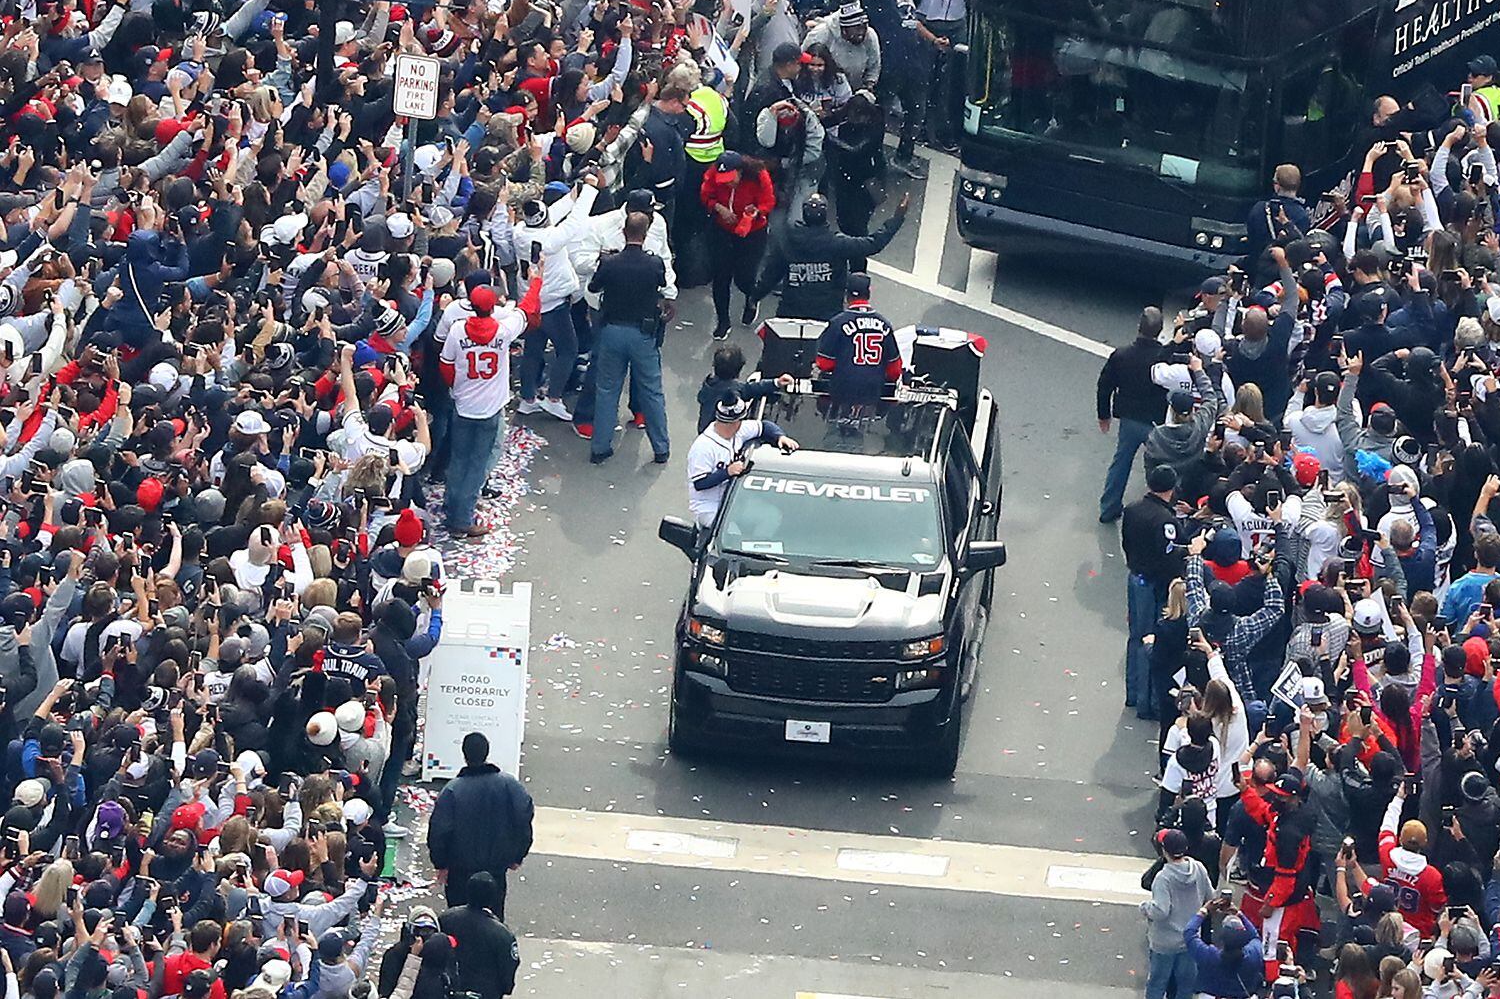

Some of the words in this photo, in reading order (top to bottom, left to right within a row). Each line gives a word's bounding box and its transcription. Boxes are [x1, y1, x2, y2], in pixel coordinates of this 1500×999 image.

[1393, 59, 1414, 78] Official
[1415, 52, 1430, 66] Team
[1430, 34, 1460, 57] Healthcare
[410, 63, 426, 76] NO
[399, 77, 434, 93] PARKING
[406, 92, 426, 102] FIRE
[404, 101, 426, 112] LANE
[789, 272, 833, 283] EVENT
[852, 332, 884, 365] 15
[466, 351, 499, 380] 13
[743, 475, 931, 504] CHEVROLET
[341, 659, 369, 681] TRAIN
[460, 674, 491, 685] ROAD
[440, 684, 511, 697] TEMPORARILY
[453, 696, 495, 707] CLOSED
